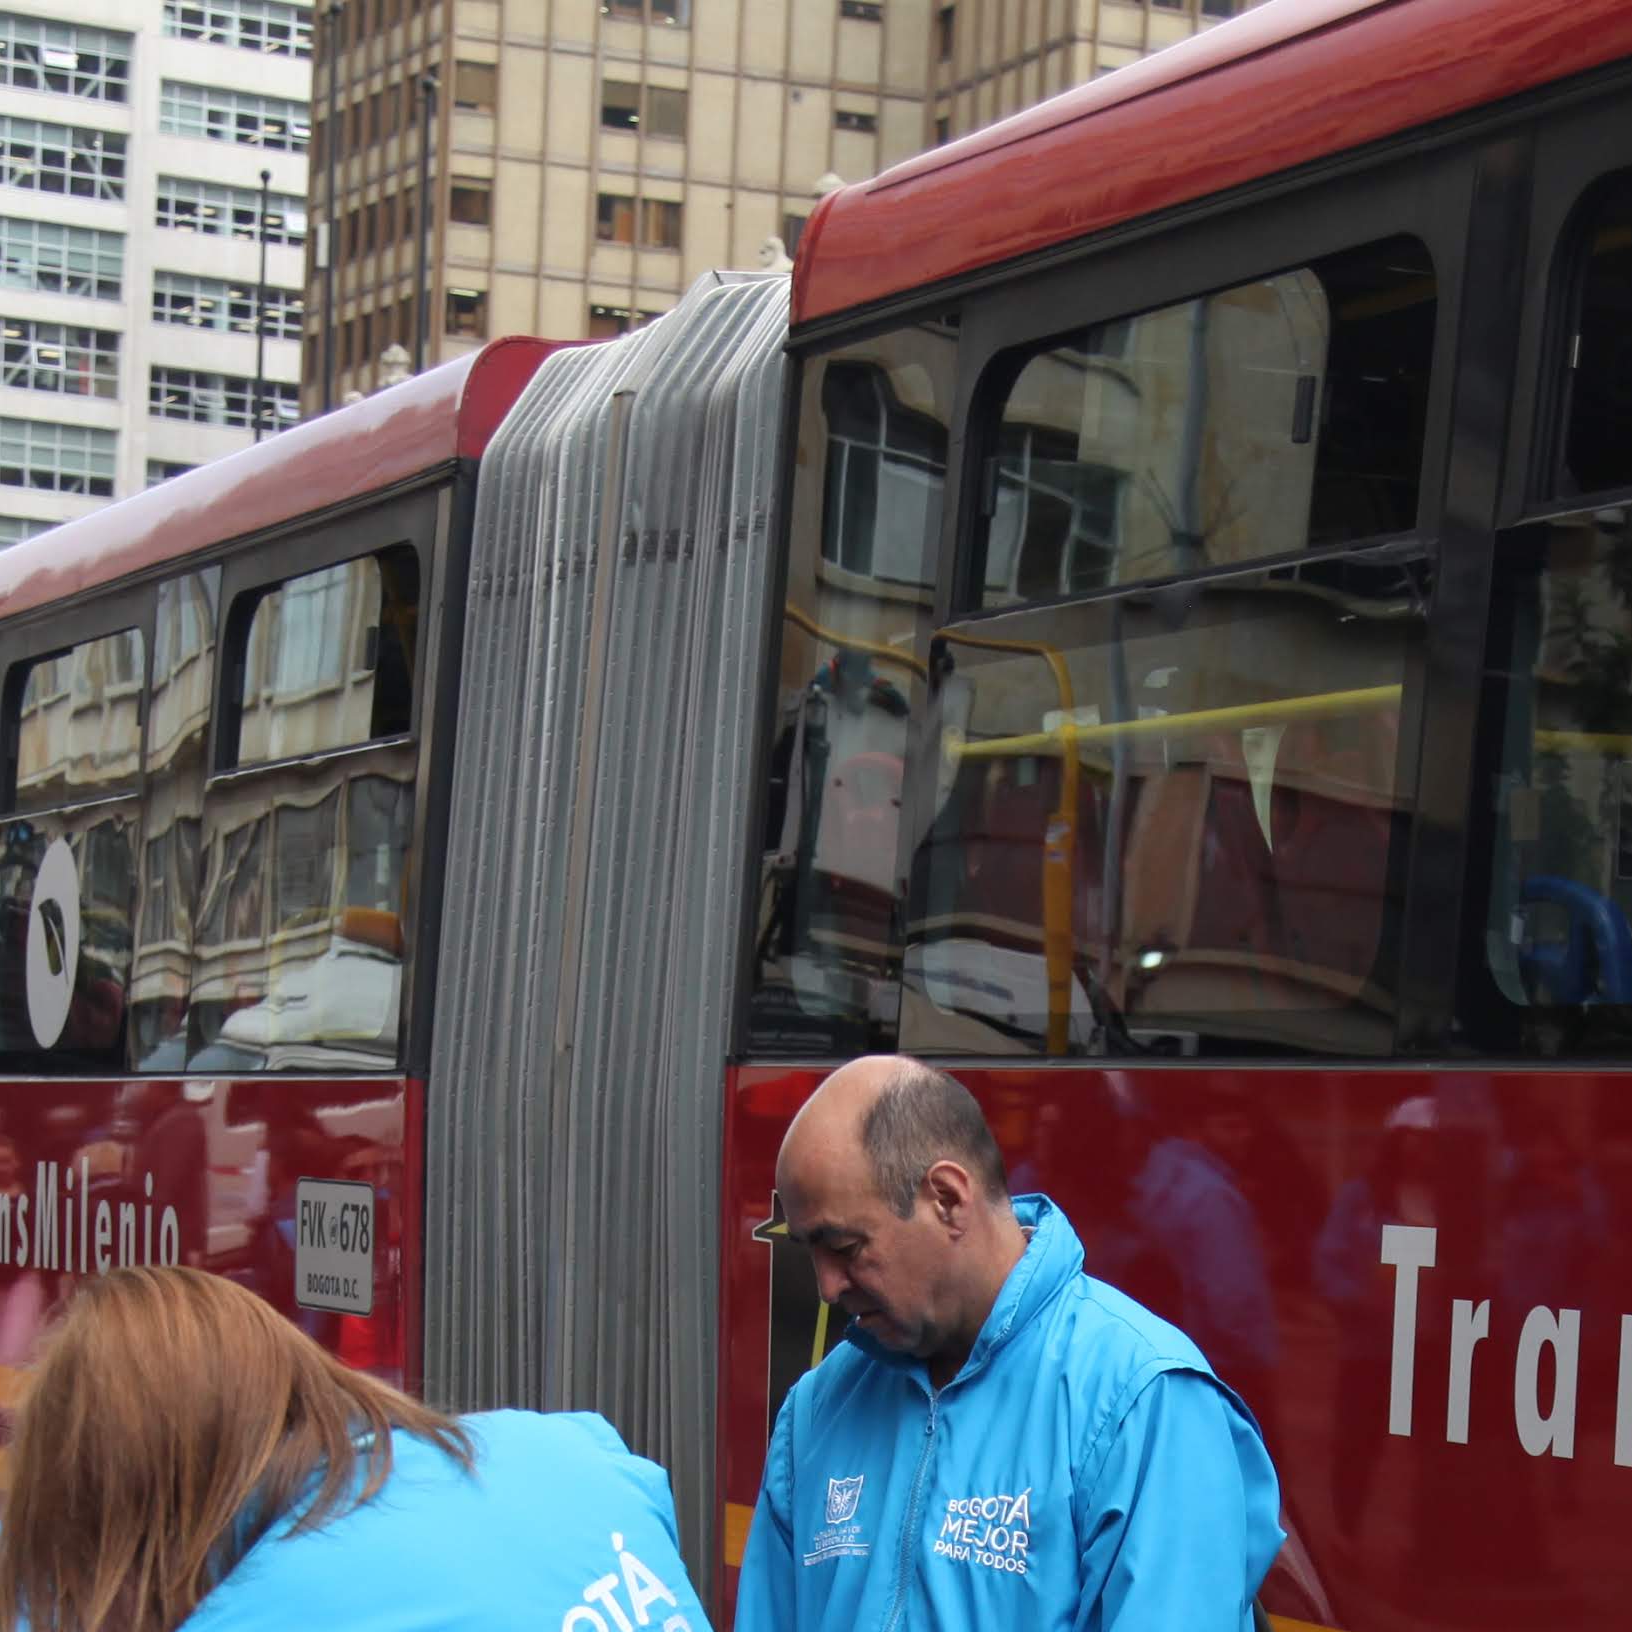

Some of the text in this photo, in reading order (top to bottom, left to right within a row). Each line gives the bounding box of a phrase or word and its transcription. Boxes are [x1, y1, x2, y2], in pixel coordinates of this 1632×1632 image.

[300, 1200, 371, 1255] FVK 678
[307, 1273, 360, 1299] BOGOTA D.C.
[947, 1486, 1031, 1530] BOGOTÁ
[933, 1539, 1027, 1575] PARA TODOS
[939, 1512, 1029, 1558] MEJOR
